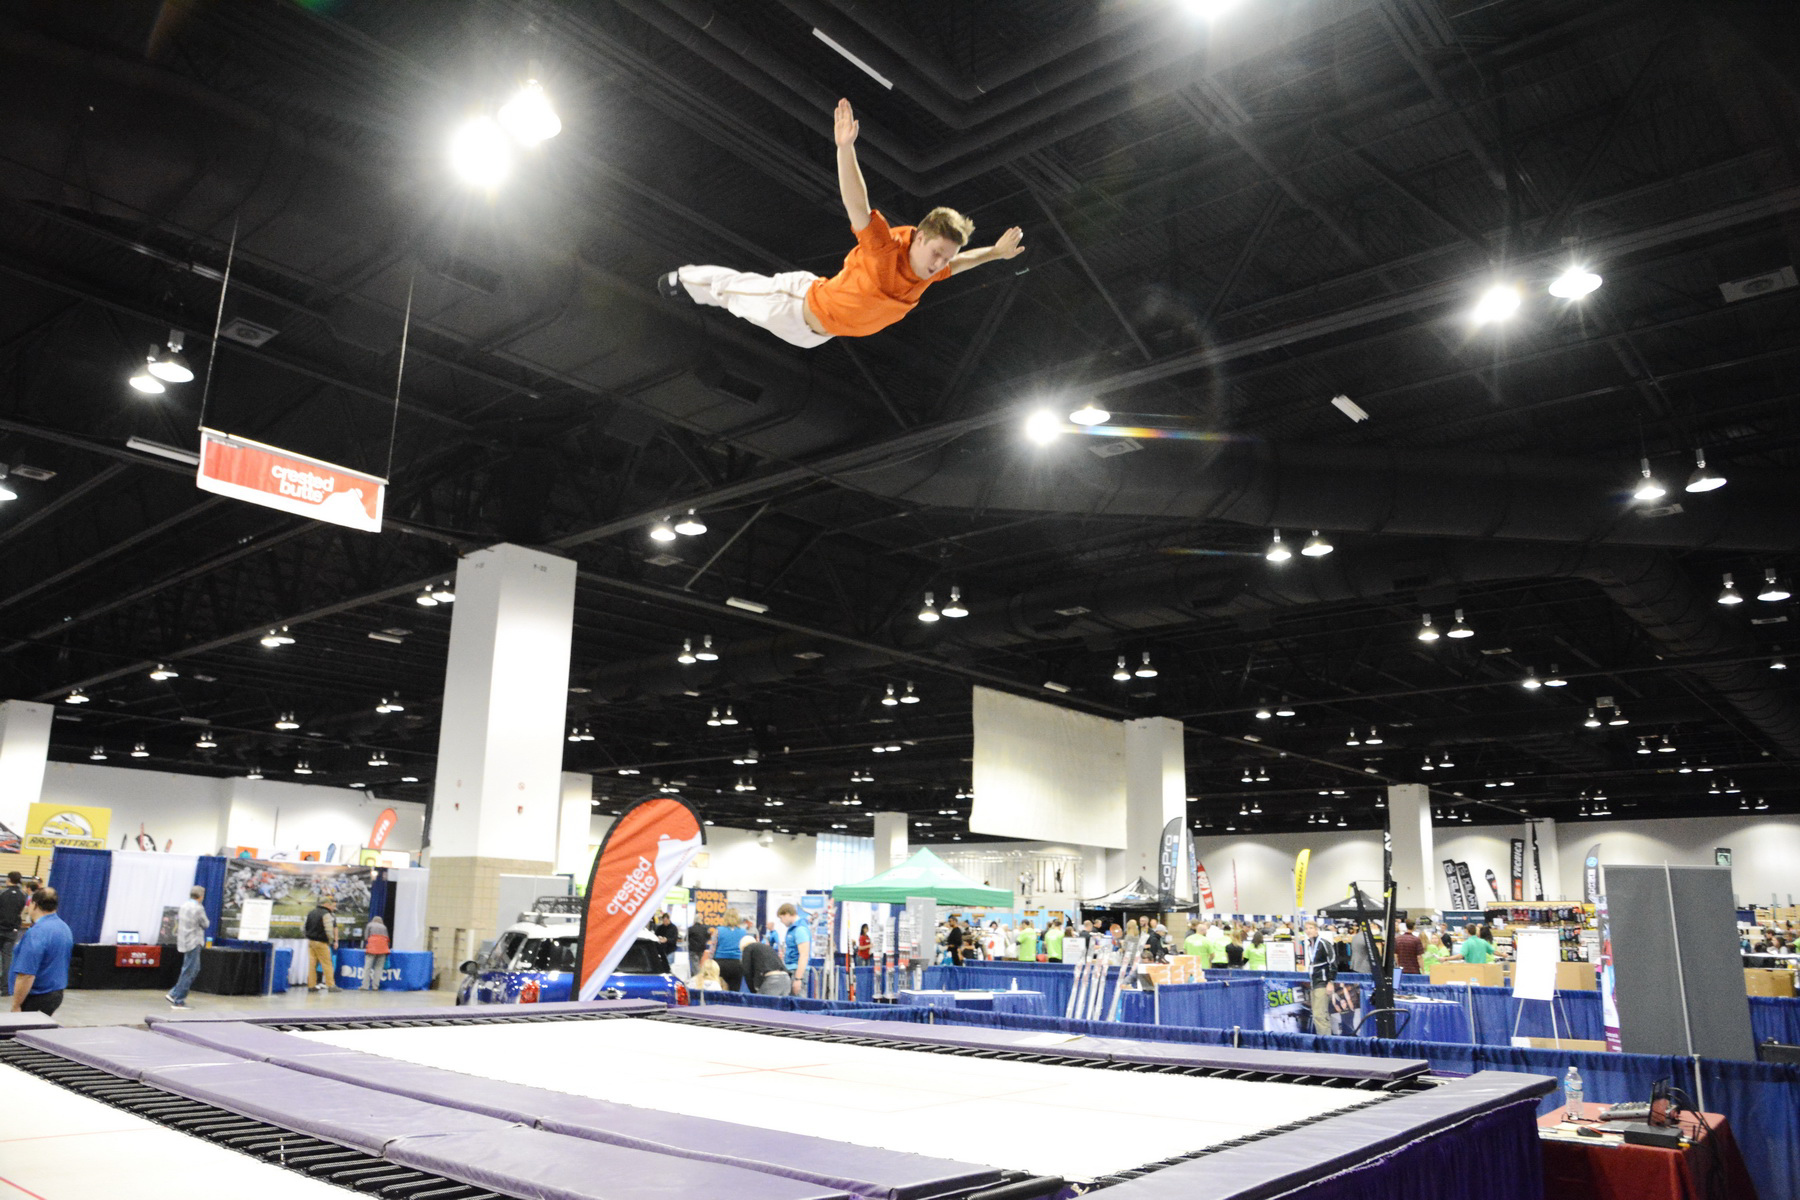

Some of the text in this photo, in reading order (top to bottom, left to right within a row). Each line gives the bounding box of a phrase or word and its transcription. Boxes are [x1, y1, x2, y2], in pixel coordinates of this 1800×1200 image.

[271, 465, 335, 492] crested
[279, 479, 324, 503] butte
[1161, 834, 1173, 890] GoPro
[606, 856, 652, 915] crested
[621, 875, 657, 916] butte
